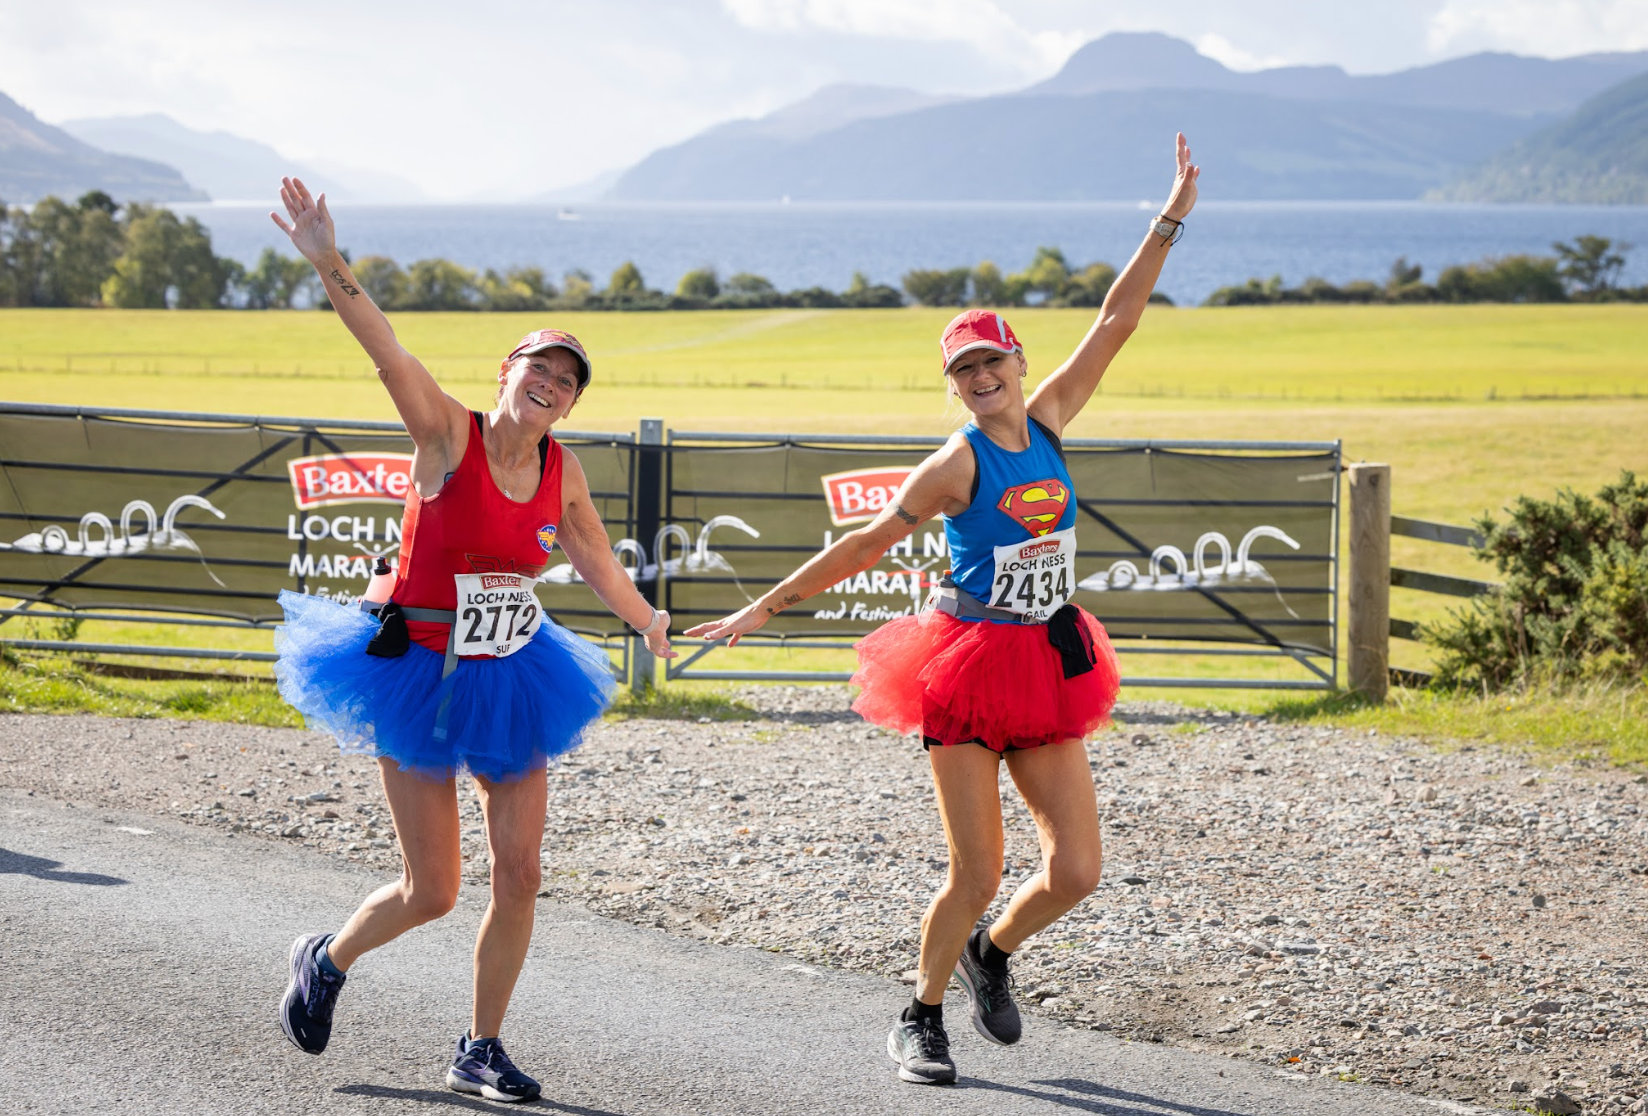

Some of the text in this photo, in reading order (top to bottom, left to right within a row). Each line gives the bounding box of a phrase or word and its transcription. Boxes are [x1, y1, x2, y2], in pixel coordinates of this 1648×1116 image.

[303, 463, 410, 497] Baxte
[288, 514, 375, 542] LOCH
[1002, 553, 1066, 572] LOCH NESS
[1022, 543, 1059, 558] Baxters
[467, 592, 505, 604] LOCH
[994, 566, 1069, 608] 2434
[462, 603, 537, 643] 2772
[814, 601, 912, 621] and Festival
